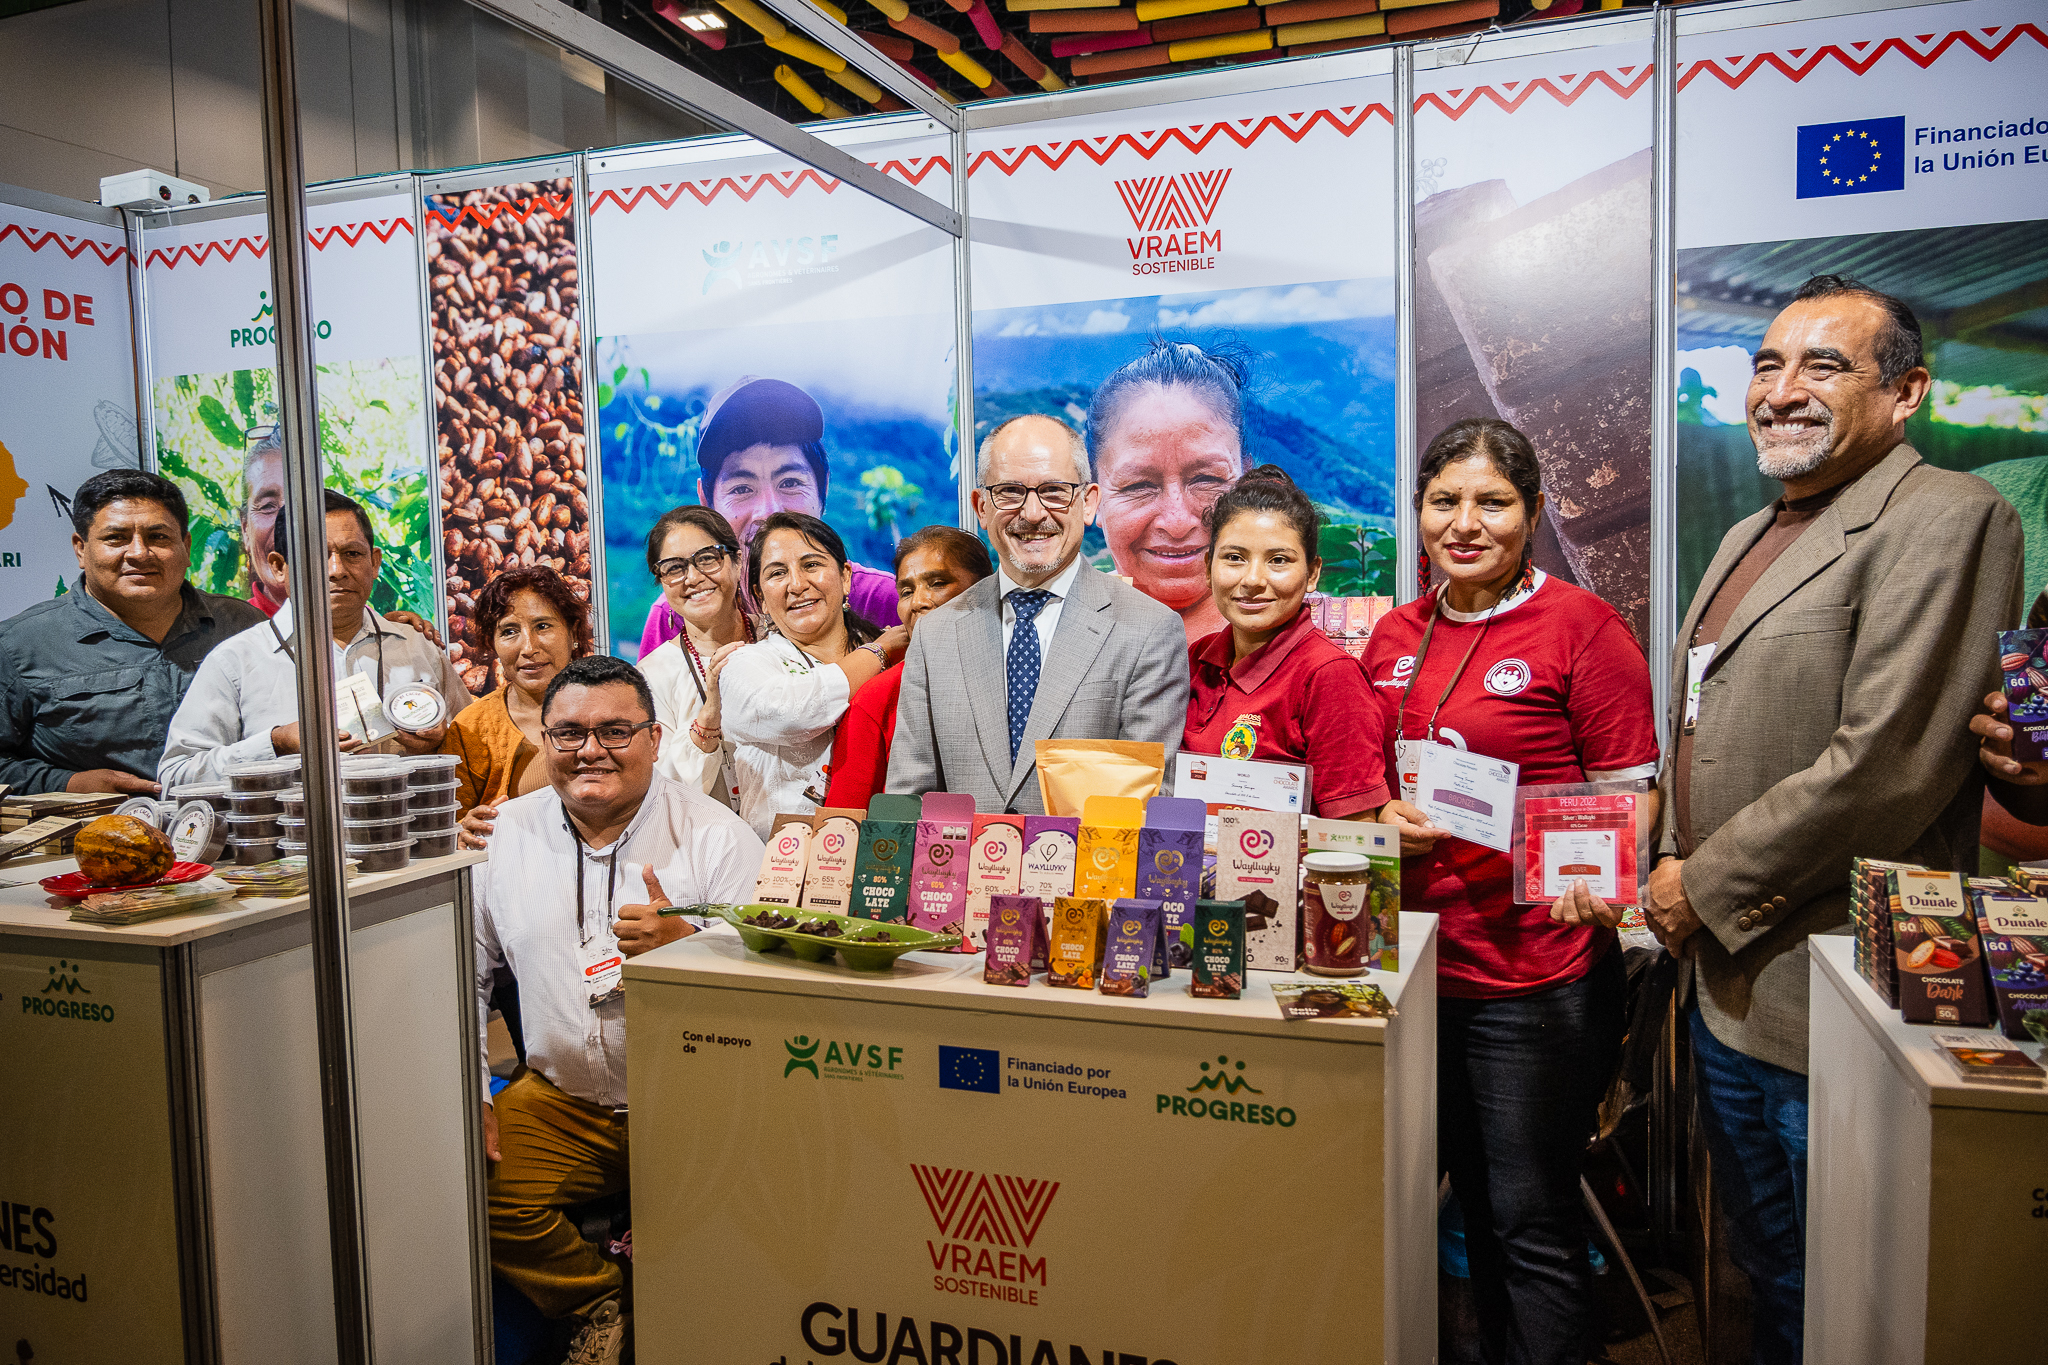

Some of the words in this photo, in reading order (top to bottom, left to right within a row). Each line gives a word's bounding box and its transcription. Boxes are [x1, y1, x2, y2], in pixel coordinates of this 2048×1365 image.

[1914, 155, 1934, 174] la
[1943, 148, 2015, 171] Unión
[1127, 229, 1222, 260] VRAEM
[747, 234, 839, 270] AVSF
[1132, 256, 1215, 276] SOSTENIBLE
[43, 288, 95, 327] DE
[230, 319, 332, 348] PROO
[0, 551, 22, 568] RI
[1448, 793, 1475, 809] BRONZE
[1559, 797, 1578, 807] PERU
[1580, 796, 1597, 806] 2022
[1222, 816, 1241, 825] 100%
[772, 875, 790, 883] 100%
[1039, 881, 1053, 889] 70%
[862, 885, 896, 897] CHOCO
[984, 884, 1000, 893] 60%
[864, 896, 890, 908] LATE
[920, 890, 953, 903] CHOCO
[1906, 894, 1958, 908] Duuale
[922, 901, 949, 914] LATE
[1162, 901, 1185, 913] OCO
[1165, 913, 1180, 925] TE
[1994, 916, 2048, 929] Duuale
[994, 945, 1020, 955] CHOCO
[1060, 942, 1085, 952] CHOCO
[997, 953, 1016, 963] LATE
[1062, 950, 1081, 960] LATE
[1114, 953, 1140, 963] CHOCO
[1204, 955, 1231, 964] CHOCO
[1116, 961, 1136, 970] LATE
[1206, 963, 1227, 972] LATE
[1921, 976, 1965, 986] CHOCOLATE
[1926, 982, 1964, 1001] Dark
[22, 995, 115, 1023] PROGRESO
[682, 1030, 704, 1043] Con
[705, 1033, 716, 1044] el
[717, 1035, 752, 1049] apoyo
[682, 1043, 697, 1054] de
[823, 1040, 904, 1071] AVSF
[1007, 1056, 1084, 1077] Financiado
[1086, 1066, 1112, 1080] por
[1007, 1074, 1019, 1088] la
[1022, 1075, 1063, 1092] Unión
[1067, 1081, 1128, 1100] Europea
[1156, 1093, 1298, 1128] PROGRESO
[926, 1240, 1047, 1287] VRAEM
[933, 1275, 1039, 1306] SOSTENIBLE
